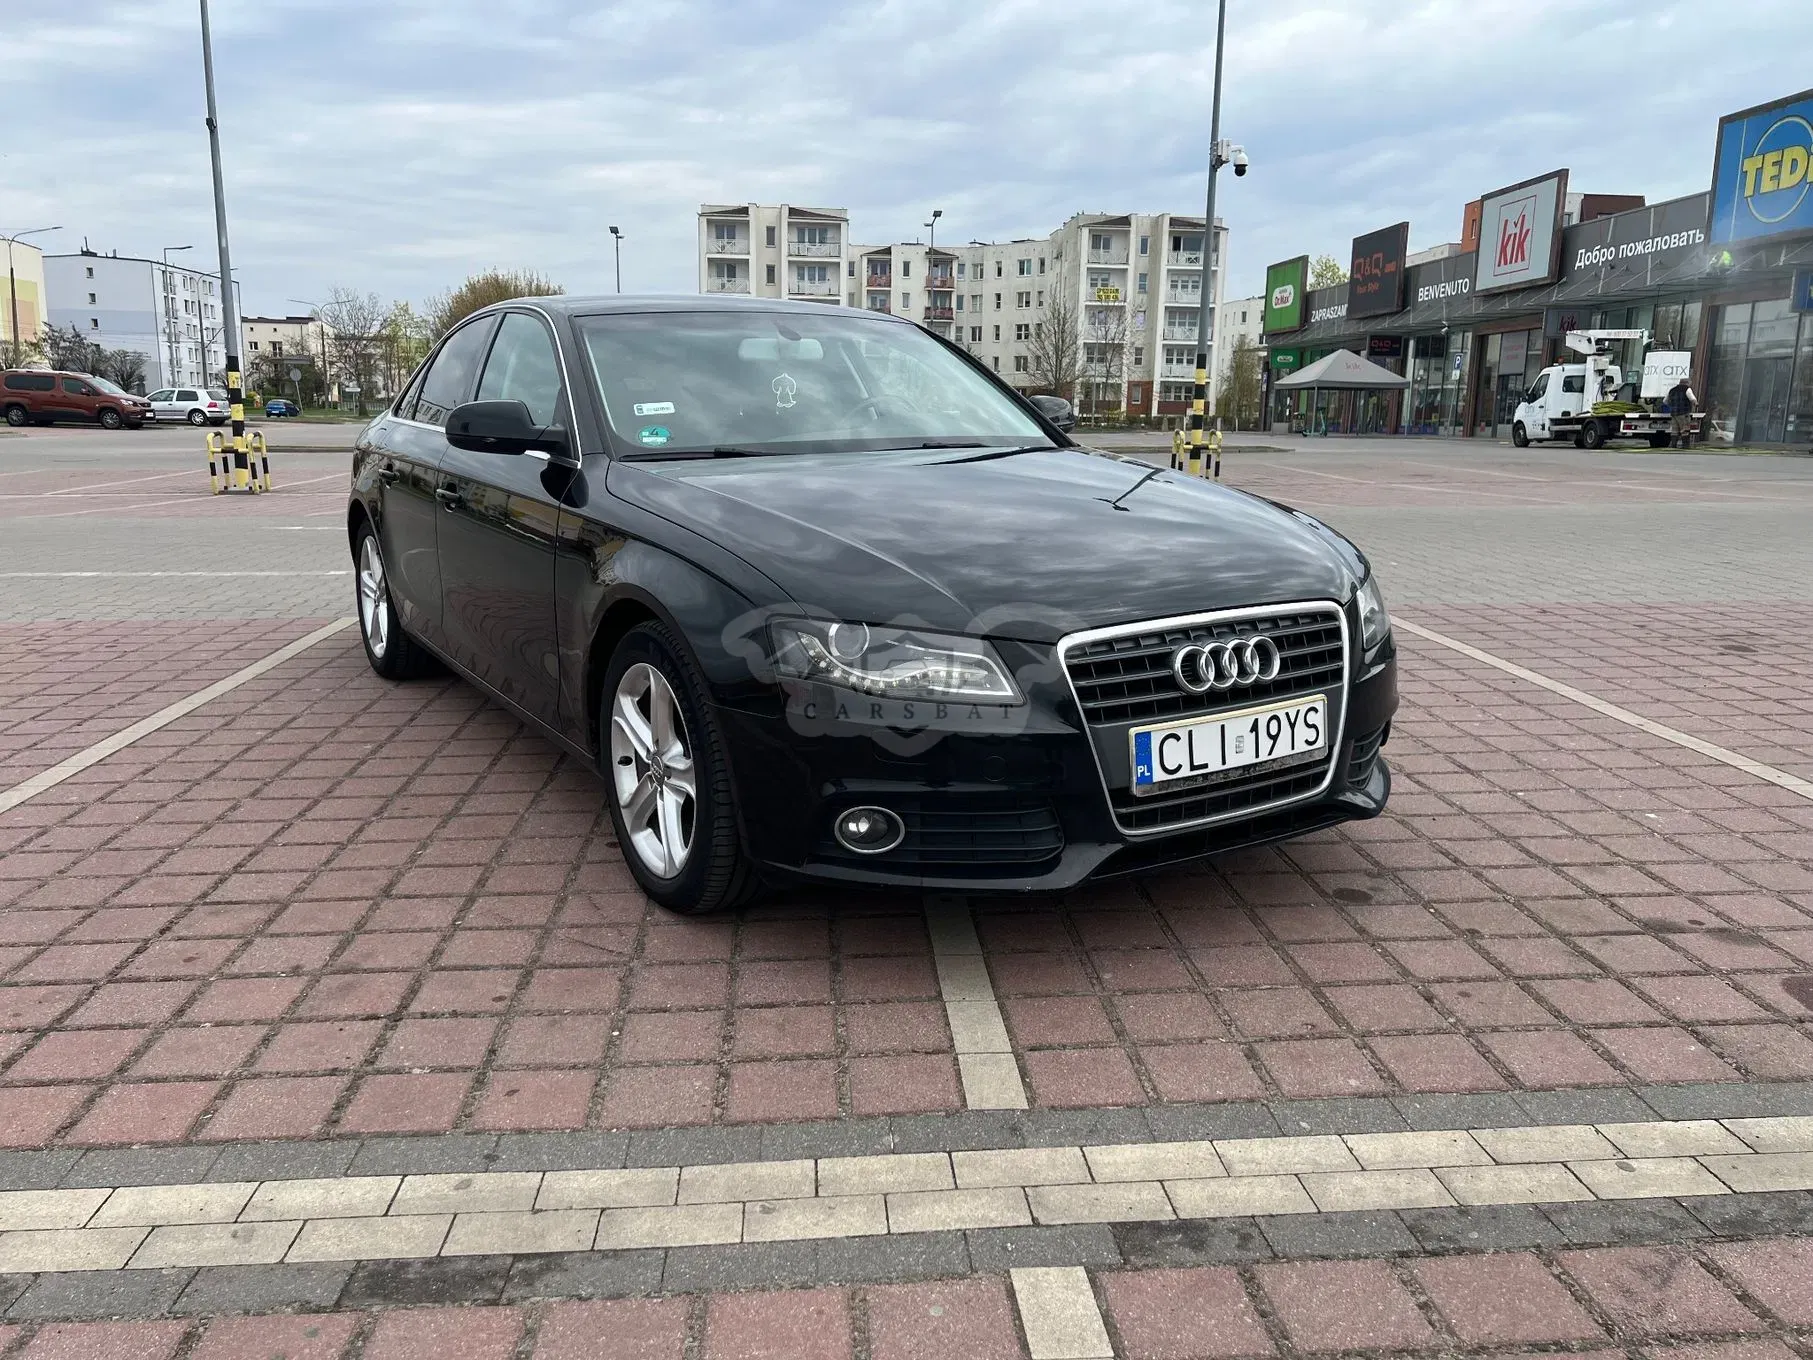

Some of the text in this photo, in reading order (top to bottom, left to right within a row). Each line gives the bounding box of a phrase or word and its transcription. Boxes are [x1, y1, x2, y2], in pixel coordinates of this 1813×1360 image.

[1497, 206, 1531, 267] kik
[1574, 228, 1705, 271] Добро пожаловать
[1418, 278, 1470, 301] BENVENUTO
[1455, 355, 1461, 369] P
[1158, 723, 1227, 776] CLI
[1249, 706, 1320, 759] 19YS
[1137, 766, 1151, 777] PL
